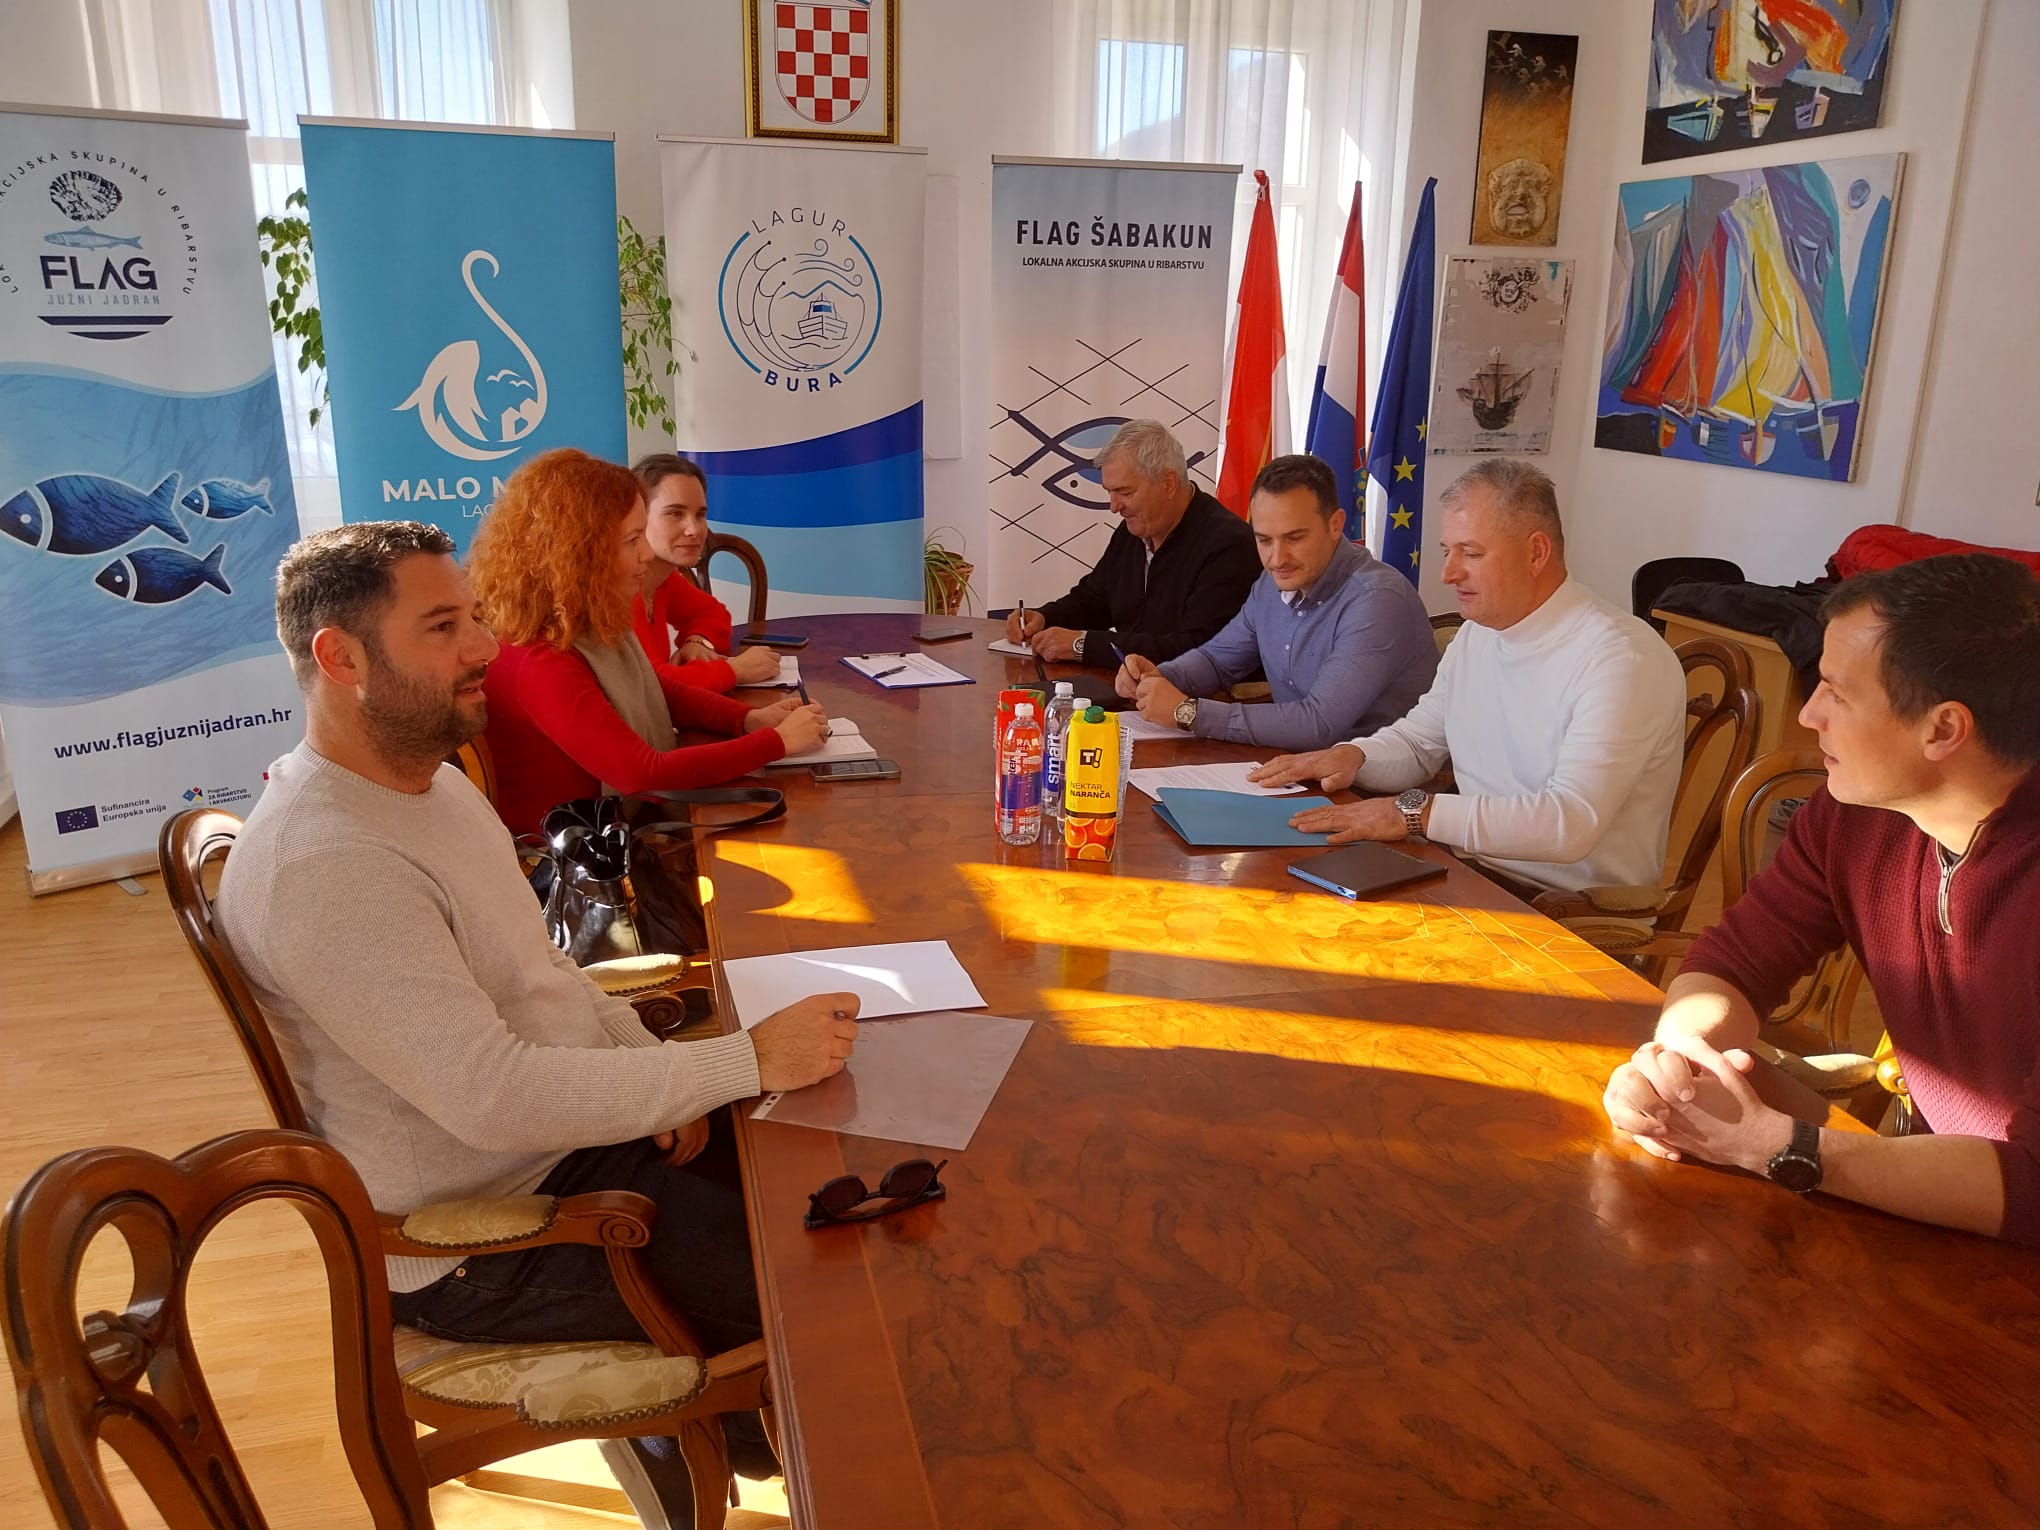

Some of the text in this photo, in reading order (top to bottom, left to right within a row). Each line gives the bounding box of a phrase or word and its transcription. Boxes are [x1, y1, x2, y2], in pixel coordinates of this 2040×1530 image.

[71, 151, 149, 183] SKUPINA
[158, 188, 167, 197] U
[171, 205, 198, 295] RIBARSTVU
[752, 207, 846, 237] LAGUR
[1016, 216, 1212, 249] FLAG ŠABAKUN
[39, 255, 159, 290] FLAG
[1022, 257, 1205, 270] LOKALNA AKCIJSKA SKUPINA U RIBARSTVU
[48, 294, 160, 305] JUŽNI JADRAN
[764, 369, 842, 393] BURA
[382, 476, 481, 503] MALO
[54, 708, 292, 759] www.flagjuznijadran.hr
[1048, 733, 1061, 785] smart
[1070, 789, 1111, 799] NARANČA
[1071, 781, 1102, 790] NEKTAR
[101, 798, 150, 813] Sufinancira
[103, 803, 167, 822] Europska unija
